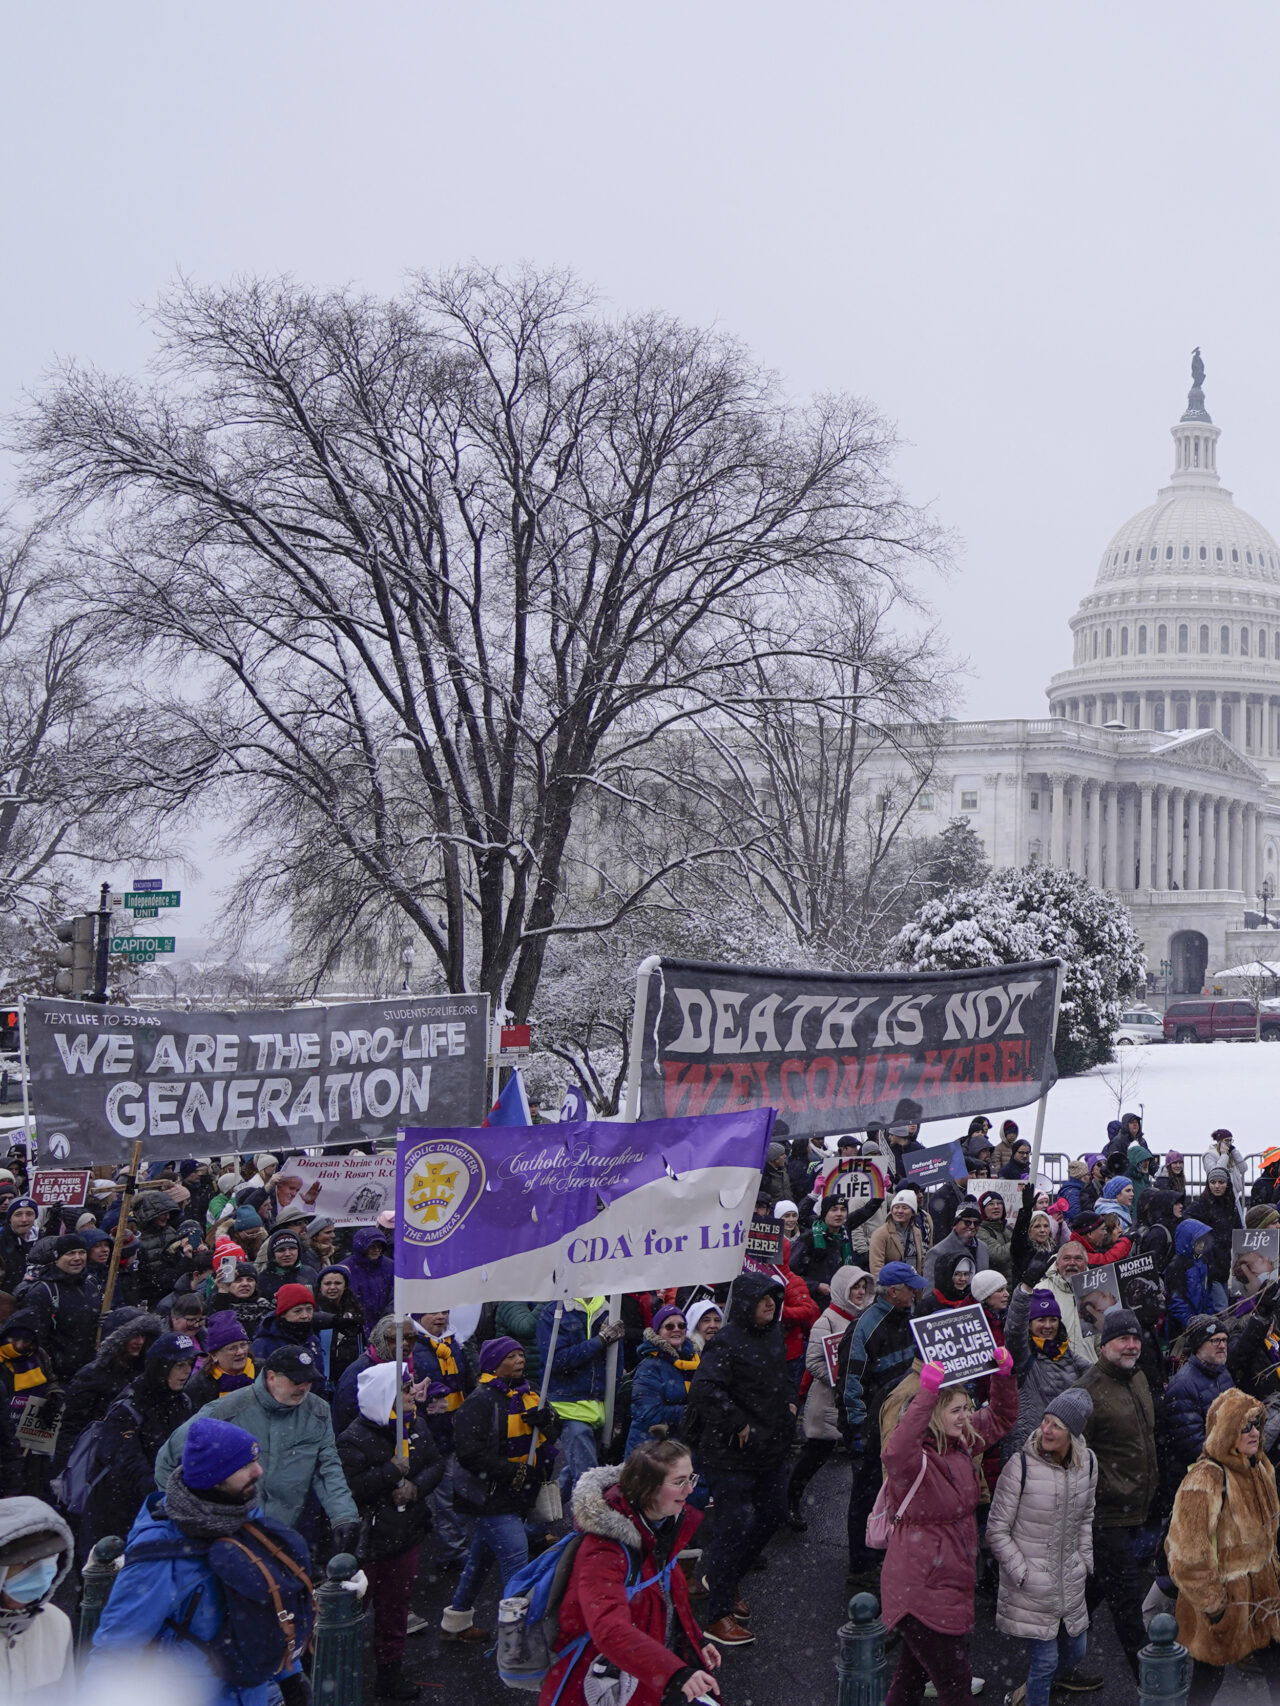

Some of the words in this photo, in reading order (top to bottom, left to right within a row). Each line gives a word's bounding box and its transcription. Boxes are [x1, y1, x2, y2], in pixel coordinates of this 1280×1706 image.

[128, 894, 169, 908] Independence
[135, 908, 156, 917] UNIT
[112, 939, 161, 952] CAPITOL
[130, 953, 154, 962] 100
[44, 1012, 72, 1026] TEXT
[76, 1013, 99, 1026] LIFE
[102, 1014, 119, 1026] TO
[123, 1015, 161, 1027] 53445
[383, 1005, 478, 1021] STUDENTSFORLIFE.ORG
[664, 988, 879, 1055] DEATH
[873, 993, 939, 1047] IS
[942, 981, 1043, 1041] NOT
[53, 1033, 135, 1075] WE
[145, 1034, 241, 1074] ARE
[248, 1032, 321, 1071] THE
[329, 1022, 467, 1068] PRO-LIFE
[662, 1055, 912, 1119] WELCOME
[911, 1040, 1033, 1099] HERE!
[105, 1066, 432, 1139] GENERATION
[297, 1159, 340, 1168] Diocesan
[343, 1159, 372, 1168] Shrine
[374, 1158, 384, 1167] of
[404, 1145, 435, 1174] ATHOLIC
[437, 1144, 479, 1175] DAUGHTERS
[497, 1149, 572, 1179] Catholic
[572, 1142, 646, 1176] Daughters
[837, 1158, 872, 1174] LIFE
[912, 1160, 931, 1169] Defend
[935, 1160, 948, 1168] their
[39, 1177, 55, 1185] LET
[57, 1177, 81, 1185] THEIR
[318, 1170, 341, 1181] Holy
[345, 1170, 375, 1181] Rosary
[521, 1172, 538, 1194] of
[540, 1170, 557, 1187] the
[549, 1167, 620, 1195] Americas
[36, 1185, 82, 1194] HEARTS
[836, 1181, 870, 1198] LIFE
[42, 1194, 72, 1202] BEAT
[406, 1228, 422, 1240] THE
[424, 1213, 460, 1241] AMERICAS
[750, 1222, 772, 1233] EATH
[772, 1224, 780, 1234] IS
[567, 1235, 632, 1263] CDA
[643, 1229, 688, 1255] for
[747, 1238, 779, 1253] HERE!
[1242, 1231, 1270, 1250] Life
[1119, 1255, 1153, 1273] WORTH
[1120, 1264, 1154, 1278] PROTECTING
[1083, 1269, 1107, 1290] Life
[923, 1333, 929, 1344] I
[934, 1326, 954, 1342] AM
[957, 1320, 982, 1334] THE
[925, 1331, 992, 1363] PRO-LIFE
[942, 1348, 995, 1374] ENERATION
